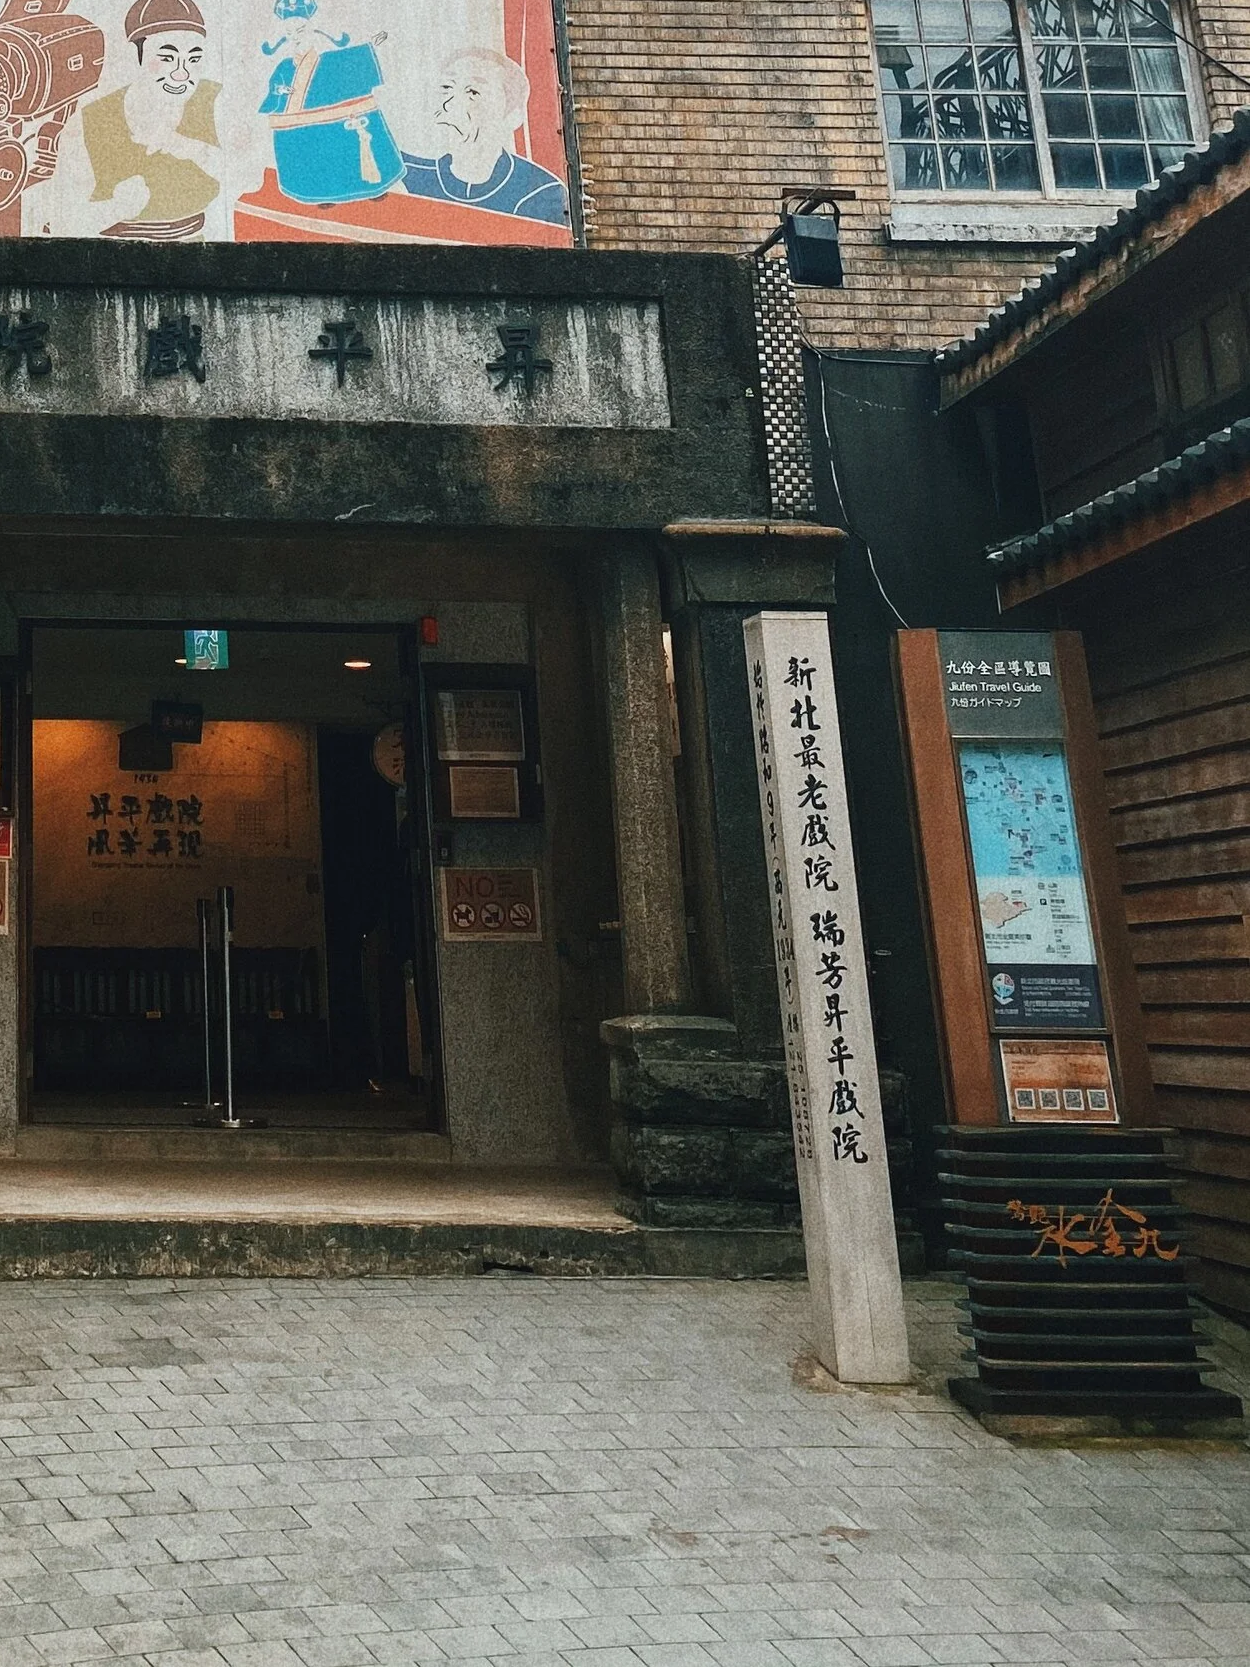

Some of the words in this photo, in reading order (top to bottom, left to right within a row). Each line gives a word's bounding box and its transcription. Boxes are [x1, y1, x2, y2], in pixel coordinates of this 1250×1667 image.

[949, 681, 978, 692] Jiufen
[980, 681, 1010, 692] Travel
[1012, 682, 1042, 693] Guide
[456, 876, 495, 898] NO
